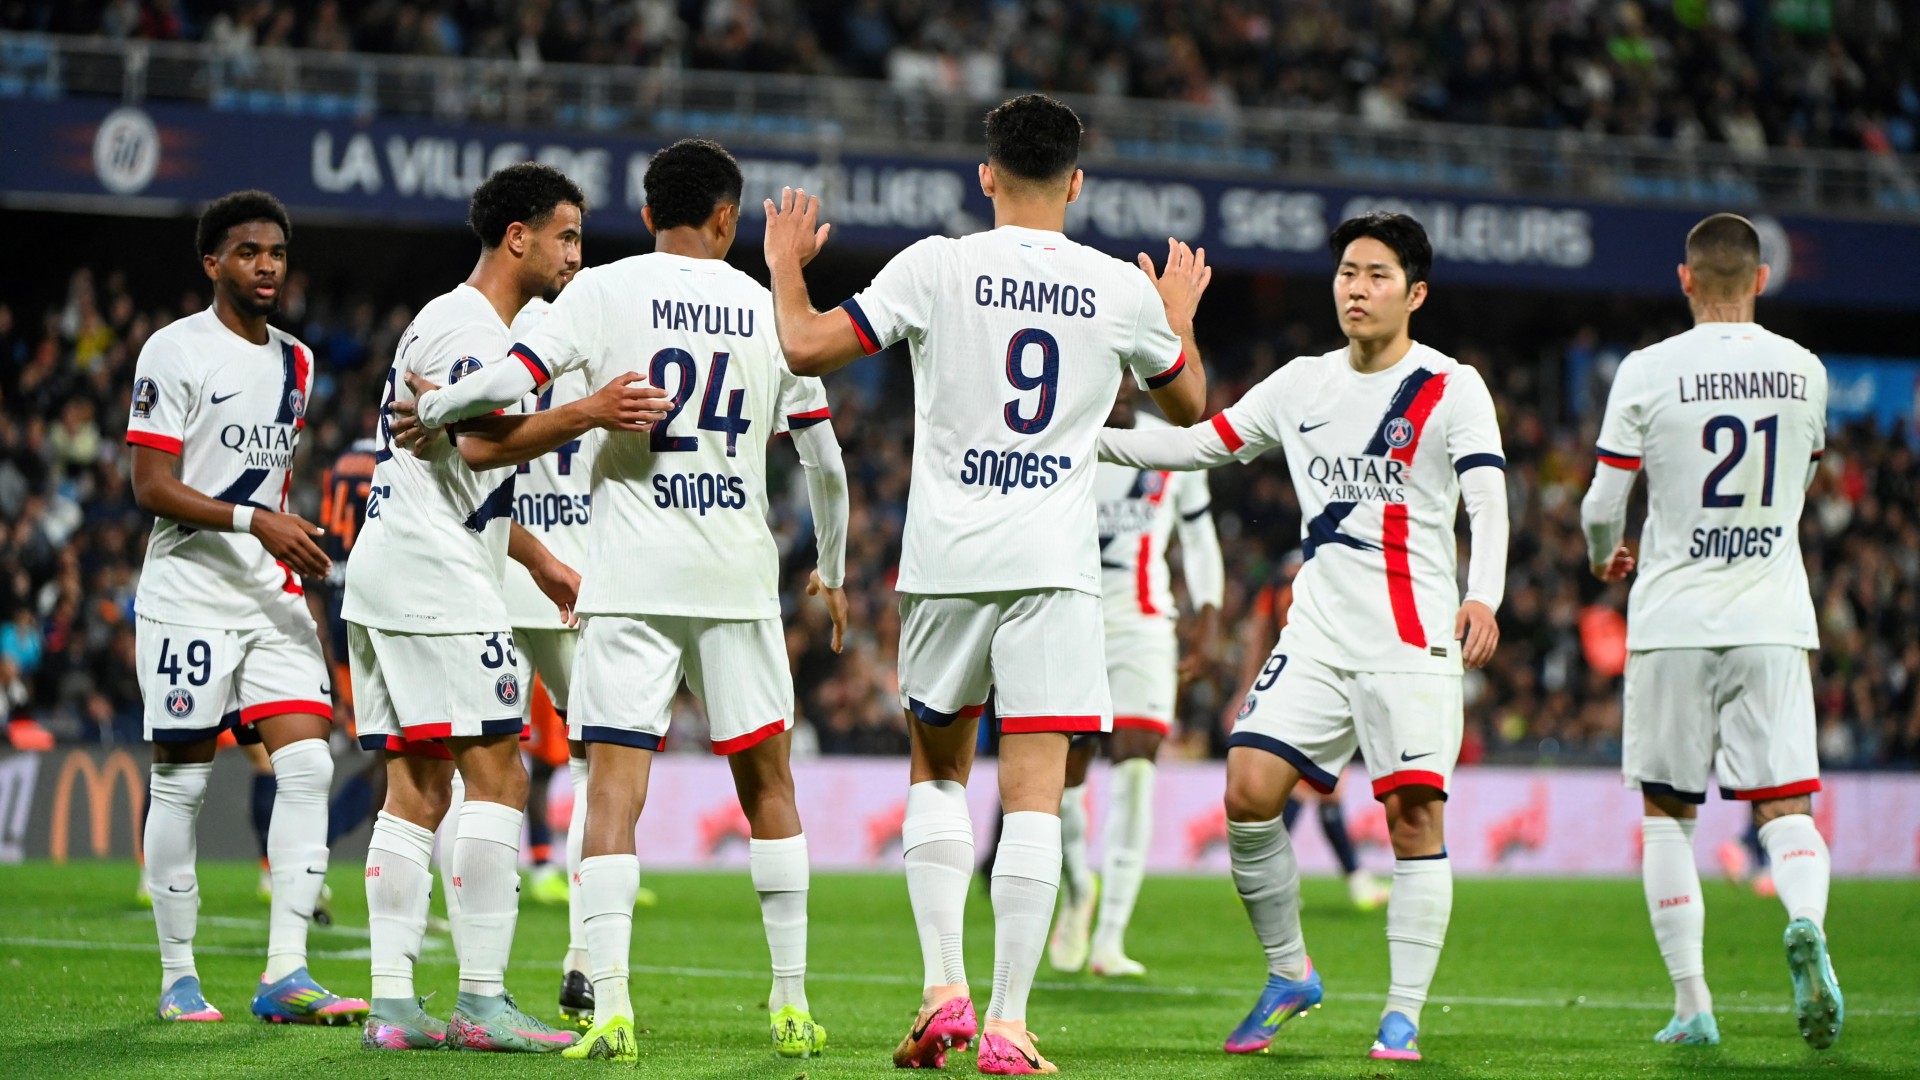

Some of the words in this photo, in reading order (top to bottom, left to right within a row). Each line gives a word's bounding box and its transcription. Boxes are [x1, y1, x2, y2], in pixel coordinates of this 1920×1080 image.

[311, 130, 382, 194] LA
[975, 275, 1096, 318] G.RAMOS
[652, 299, 754, 338] MAYULU
[649, 347, 751, 457] 24
[1004, 328, 1060, 434] 9
[1679, 371, 1808, 403] L.HERNANDEZ
[244, 452, 292, 469] AIRWA
[960, 449, 1058, 495] snipes
[1308, 456, 1403, 486] QATAR
[1702, 414, 1778, 508] 21
[653, 472, 746, 516] snipes
[1329, 484, 1405, 503] AIRWAYS
[1690, 527, 1774, 564] snipes
[157, 638, 211, 687] 49
